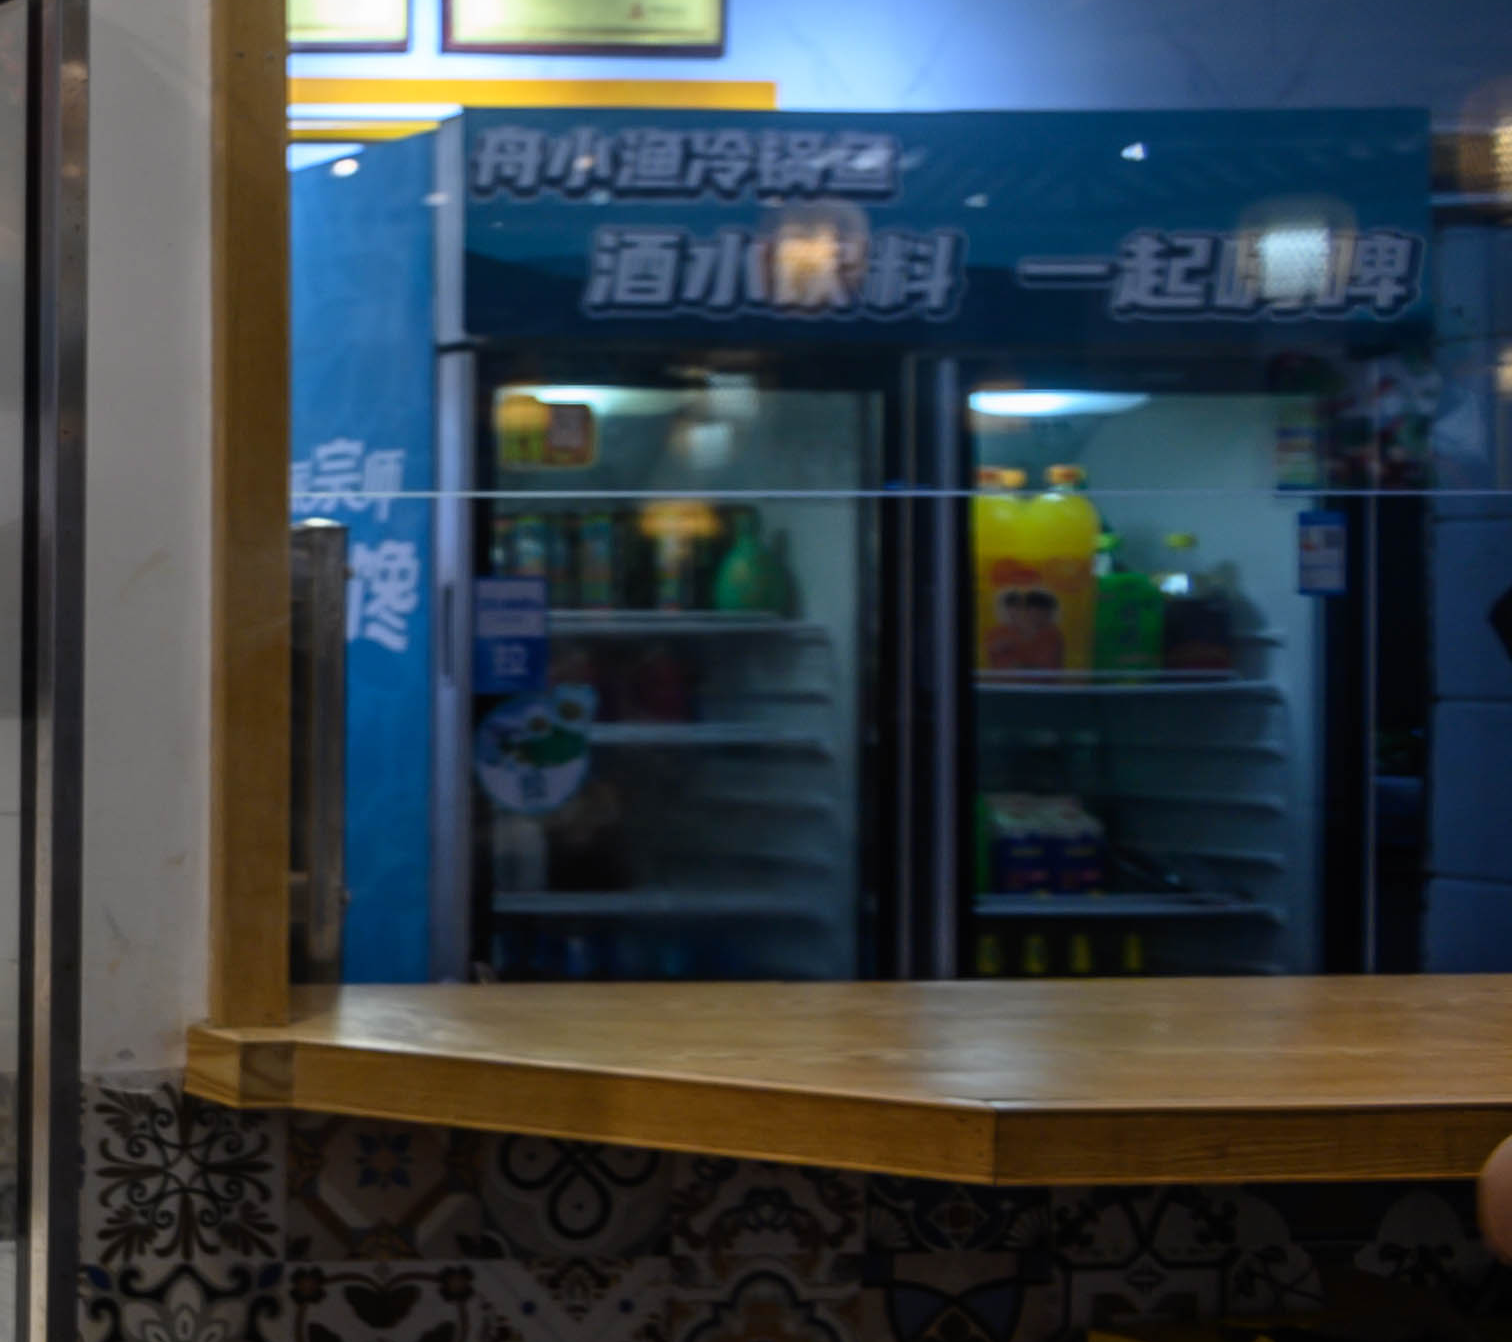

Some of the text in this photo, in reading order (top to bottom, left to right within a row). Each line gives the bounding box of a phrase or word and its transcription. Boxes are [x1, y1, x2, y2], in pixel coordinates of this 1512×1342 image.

[473, 126, 900, 197] 舟小渔冷锅鱼
